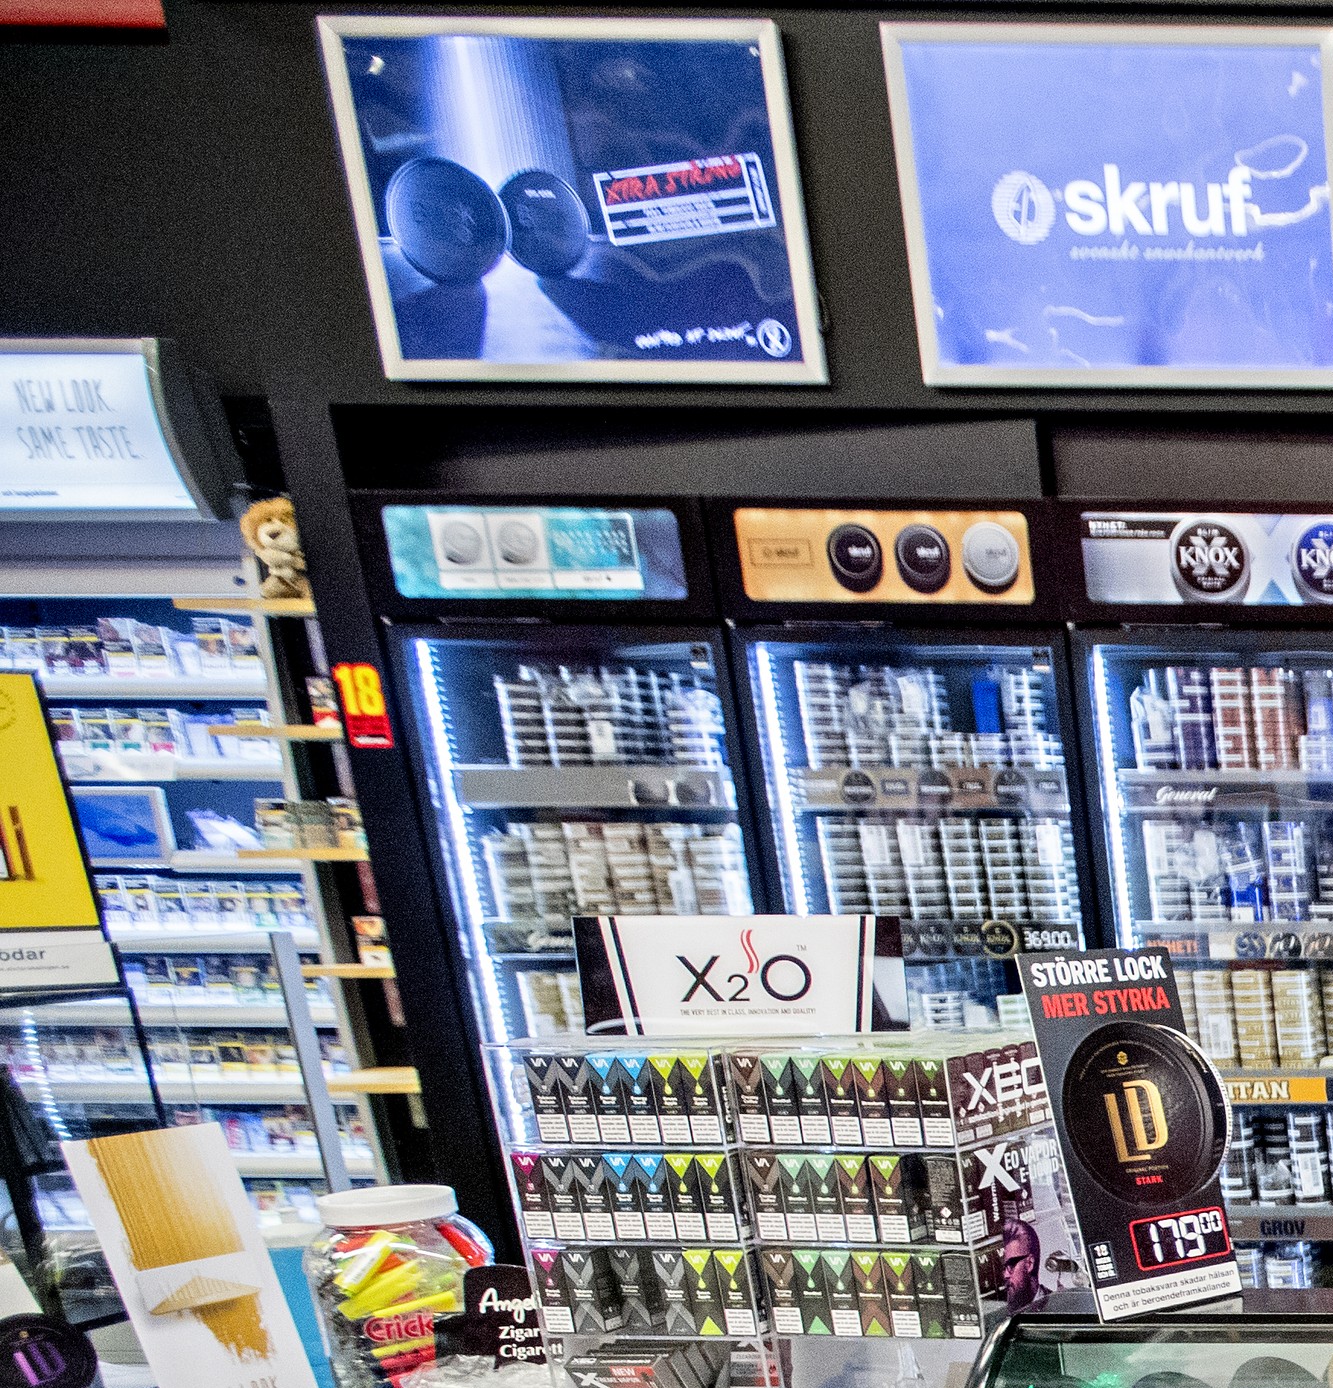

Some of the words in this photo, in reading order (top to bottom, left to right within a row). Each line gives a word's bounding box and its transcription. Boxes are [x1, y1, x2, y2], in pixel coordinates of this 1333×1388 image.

[1064, 164, 1252, 237] skruf
[14, 378, 58, 414] NEW
[18, 425, 69, 461] SAME
[1179, 545, 1241, 569] KNOX
[335, 663, 387, 716] 18
[1031, 956, 1112, 988] STÖRRE
[1115, 954, 1168, 982] LOCK
[748, 1008, 779, 1016] INNOVATION
[1041, 990, 1089, 1020] MER
[1093, 985, 1171, 1014] STYRKA
[1103, 1078, 1168, 1163] LD
[1135, 1175, 1163, 1186] STARK
[1260, 1220, 1306, 1236] GROV
[1103, 1289, 1131, 1302] Denna
[1132, 1279, 1178, 1298] tobaksvara
[1179, 1274, 1207, 1288] skadar
[1208, 1268, 1235, 1281] hälsan
[1113, 1301, 1130, 1312] och
[1131, 1299, 1141, 1309] är
[1142, 1281, 1231, 1306] beroendeframkallande
[611, 1367, 635, 1376] NEW
